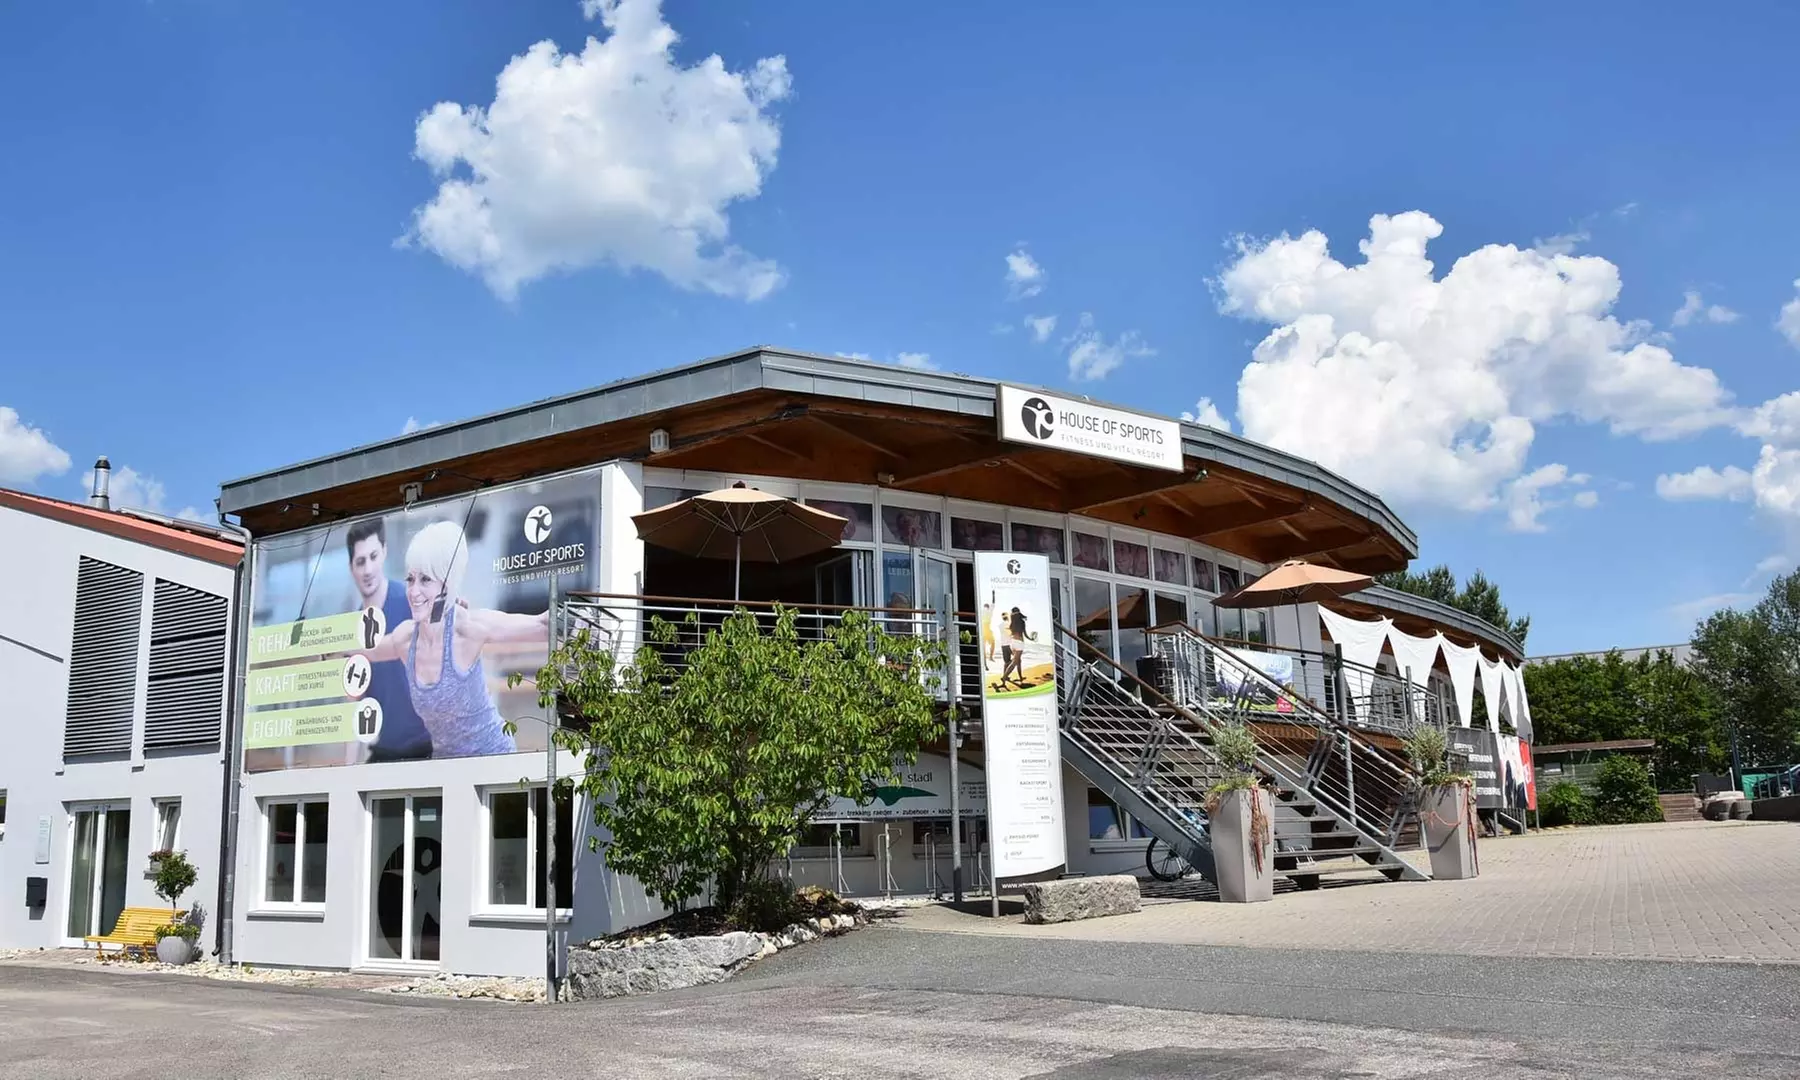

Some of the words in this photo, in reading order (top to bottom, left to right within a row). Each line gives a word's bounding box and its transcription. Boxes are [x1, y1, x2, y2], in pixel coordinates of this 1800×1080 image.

[1059, 411, 1099, 432] HOUSE
[1102, 419, 1117, 435] OF
[1119, 423, 1164, 445] SPORTS
[1061, 433, 1094, 448] FITNESS
[1096, 441, 1112, 451] UND
[1113, 444, 1135, 455] VITAL
[1137, 449, 1165, 461] RESORT
[493, 554, 527, 572] HOUSE
[528, 551, 543, 566] OF
[544, 543, 585, 563] SPORTS
[520, 573, 535, 582] UND
[557, 564, 585, 576] RESORT
[255, 673, 298, 695] KRAFT
[252, 718, 293, 739] FIGUR
[907, 772, 933, 782] stadl
